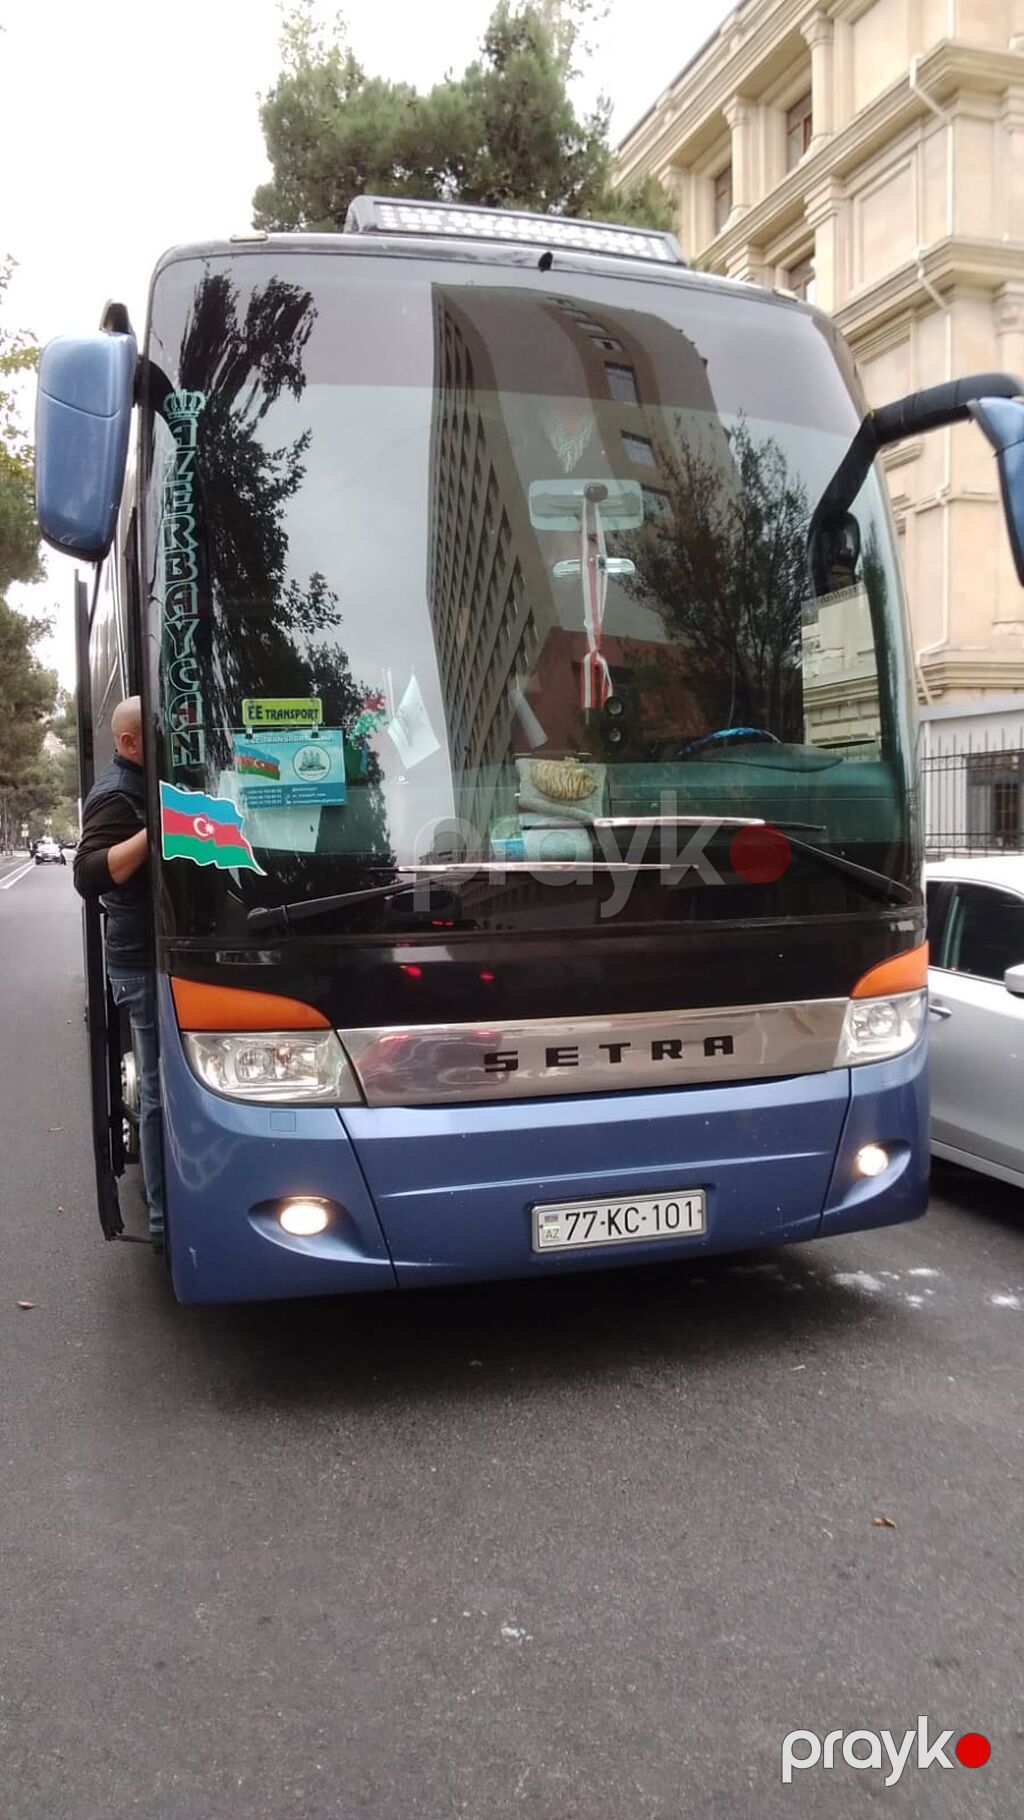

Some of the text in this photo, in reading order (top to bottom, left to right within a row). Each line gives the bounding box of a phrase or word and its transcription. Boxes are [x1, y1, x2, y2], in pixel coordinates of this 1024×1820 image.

[248, 706, 319, 720] EE TRANSPORT
[484, 1035, 734, 1073] SETRA
[546, 1228, 560, 1239] AZ
[565, 1201, 692, 1240] 77-KC-101
